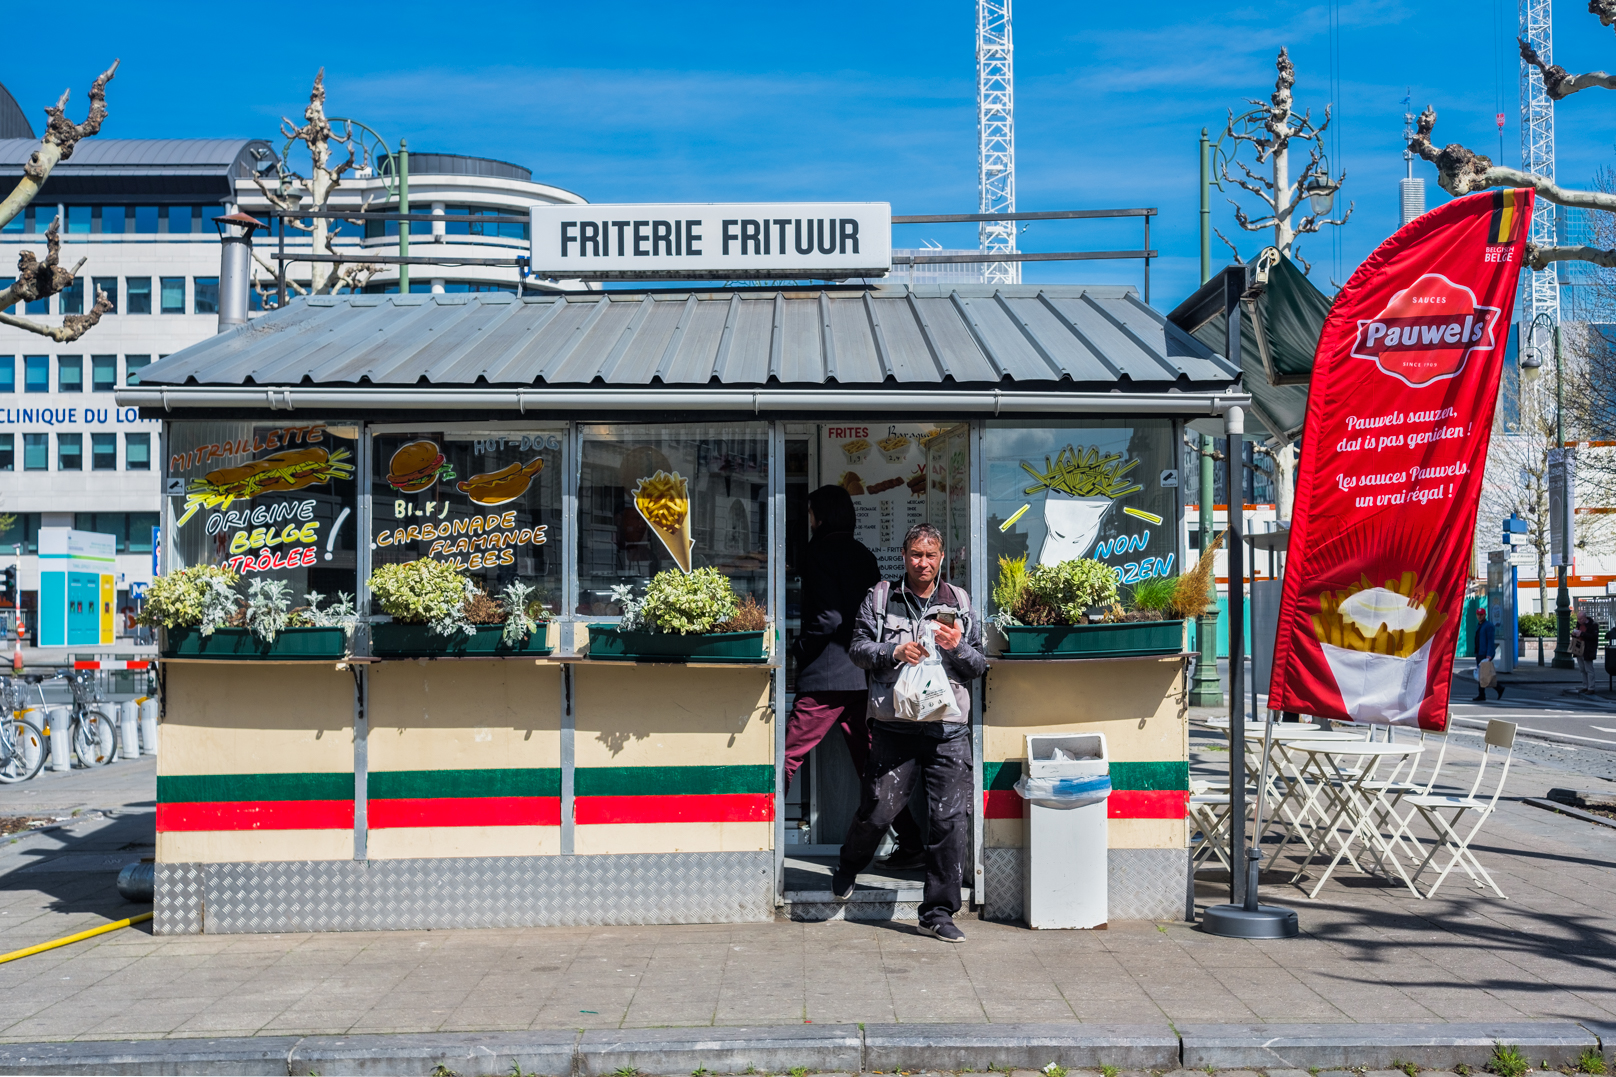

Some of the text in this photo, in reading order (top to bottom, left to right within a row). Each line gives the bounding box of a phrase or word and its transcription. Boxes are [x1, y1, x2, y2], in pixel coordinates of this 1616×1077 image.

[560, 218, 860, 257] FRITERIE FRITUUR
[1484, 252, 1514, 263] BELGE
[1412, 296, 1447, 304] SAUCES
[1366, 315, 1484, 348] Pauwels
[84, 408, 108, 424] DU
[1345, 406, 1458, 431] Pauwels sauzen,
[474, 435, 560, 456] HOT-DOG
[828, 427, 869, 438] FRITES
[1336, 438, 1361, 453] dat
[1364, 435, 1376, 450] is
[1378, 434, 1404, 452] pas
[1407, 425, 1463, 450] genieten
[170, 424, 328, 472] MITRAILLETTE
[1336, 473, 1357, 492] Les
[1359, 471, 1407, 487] sauces
[1355, 496, 1374, 508] un
[1376, 489, 1406, 505] vrai
[1407, 485, 1444, 506] régal
[206, 500, 317, 535] ORIGINE
[377, 510, 517, 547] CARBONADE
[230, 521, 320, 554] BELGE
[429, 525, 549, 557] FLAMANDE
[1093, 530, 1150, 562] NON
